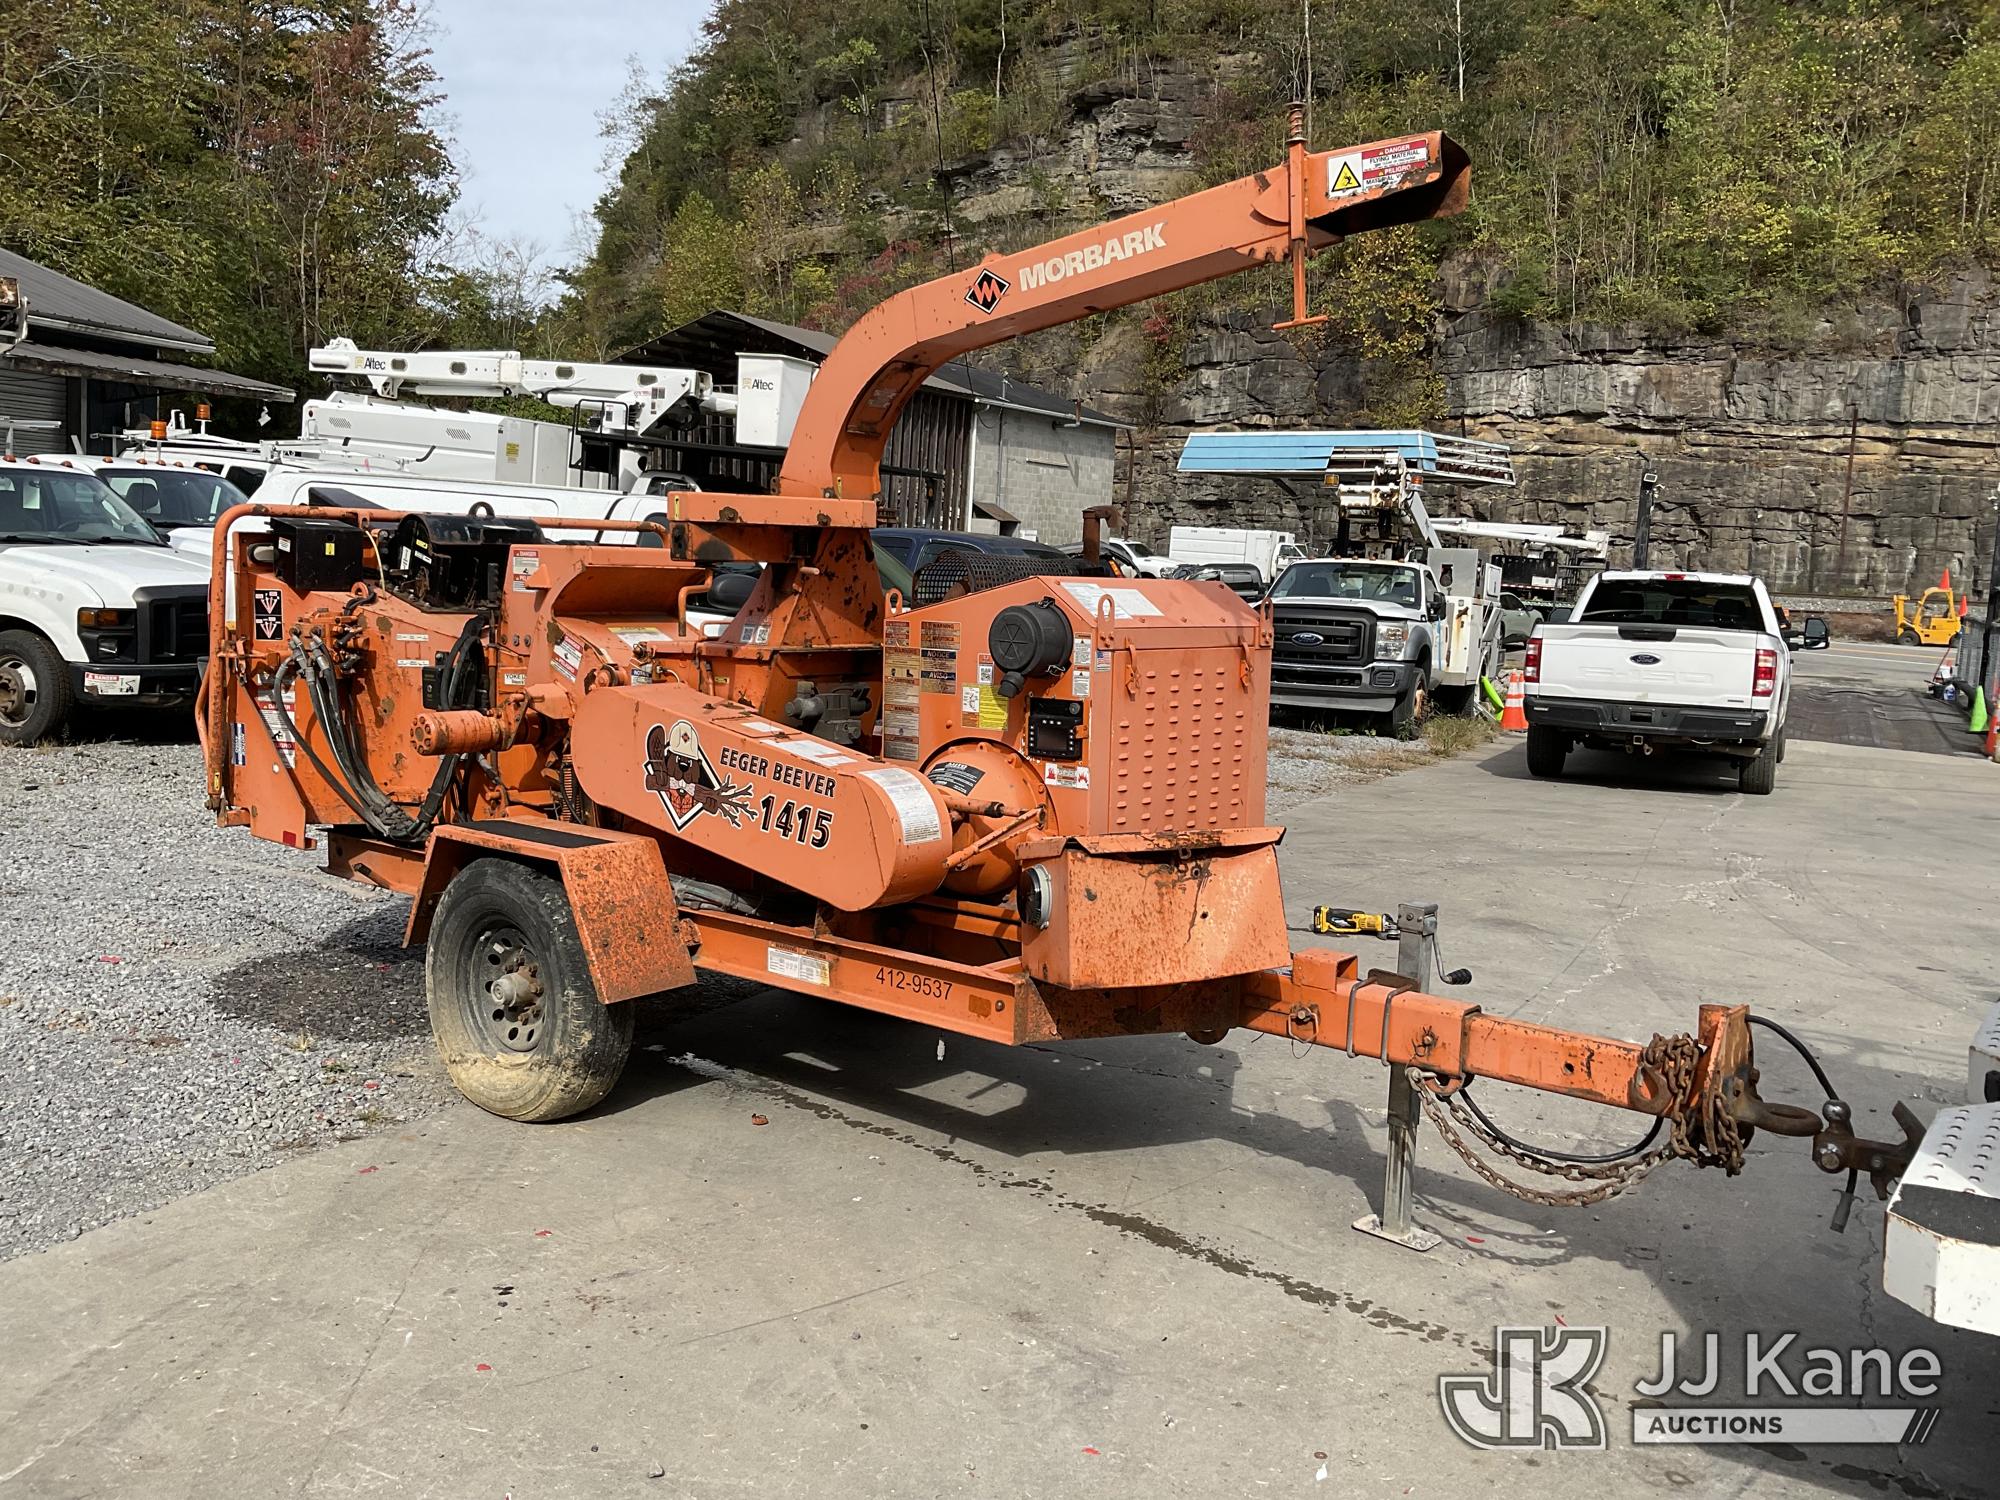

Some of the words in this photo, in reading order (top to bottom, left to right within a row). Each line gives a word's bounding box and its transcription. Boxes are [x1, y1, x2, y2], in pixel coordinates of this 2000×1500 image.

[1384, 144, 1410, 155] DANGER
[1369, 155, 1390, 165] FLYING
[1391, 149, 1420, 161] MATERIAL
[1384, 164, 1411, 175] PELIGRO
[1019, 222, 1167, 292] MORBARK
[363, 356, 386, 370] Altec
[751, 378, 774, 391] Altec
[927, 650, 950, 658] NOTICE
[928, 672, 949, 680] AVISO
[720, 746, 769, 778] EEGER
[772, 761, 836, 798] BEEVER
[760, 794, 834, 850] 1415
[875, 967, 953, 1000] 412-9537
